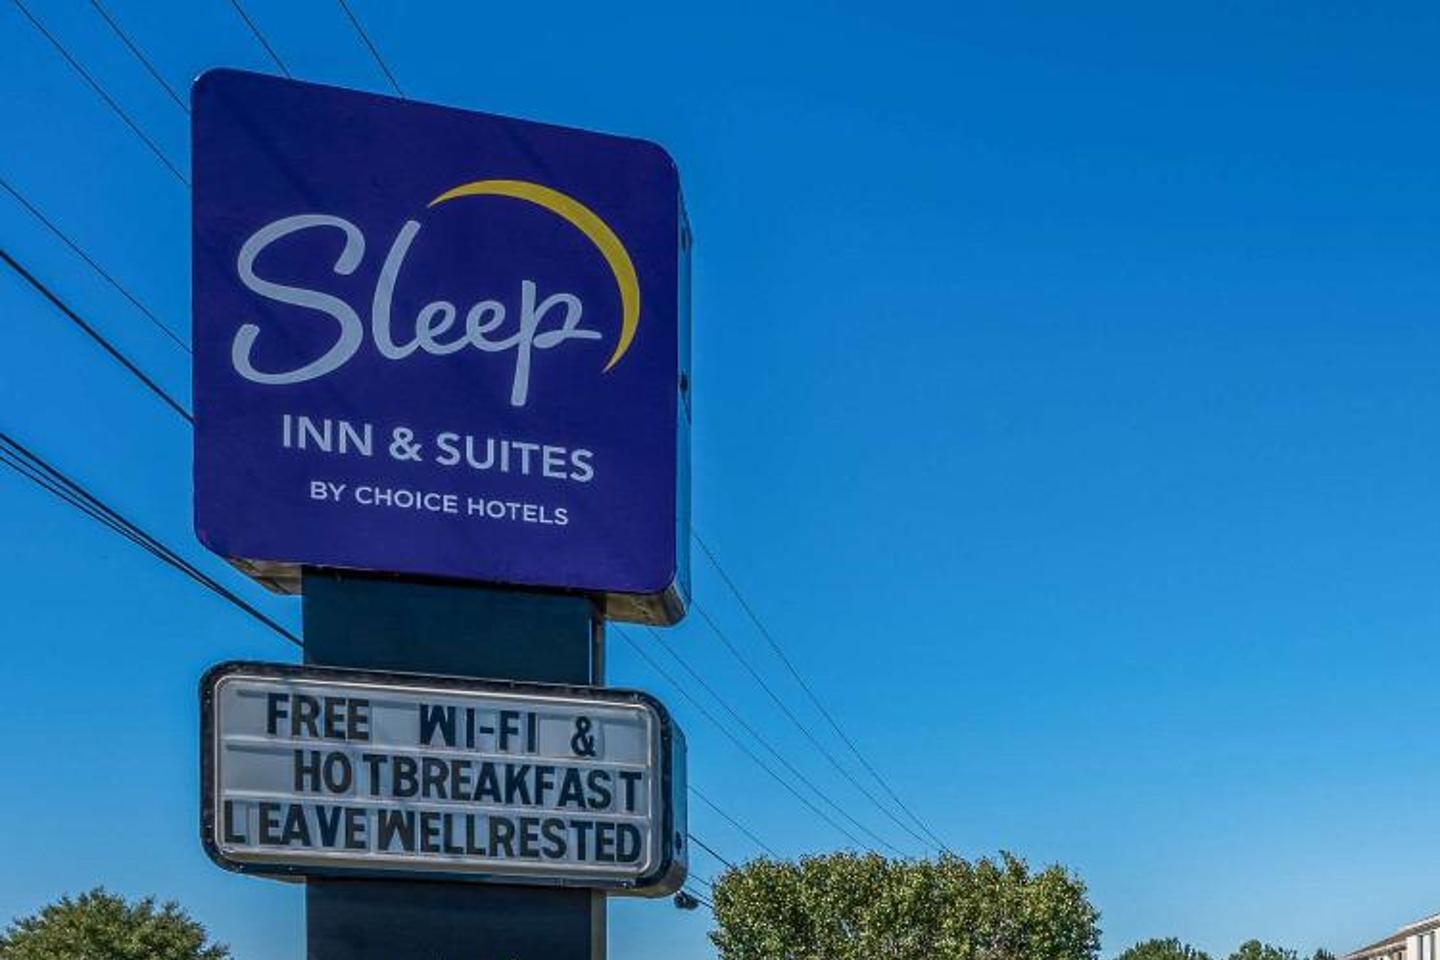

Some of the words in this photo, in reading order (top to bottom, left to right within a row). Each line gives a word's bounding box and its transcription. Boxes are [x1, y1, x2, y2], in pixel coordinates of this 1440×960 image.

[232, 214, 602, 406] Sleep
[283, 414, 373, 456] INN
[389, 427, 422, 461] &
[435, 432, 594, 482] SUITES
[310, 481, 346, 501] BY
[355, 487, 458, 513] CHOICE
[467, 498, 569, 525] HOTELS
[267, 692, 370, 741] FREE
[419, 703, 536, 754] WI-FI
[570, 716, 596, 757] &
